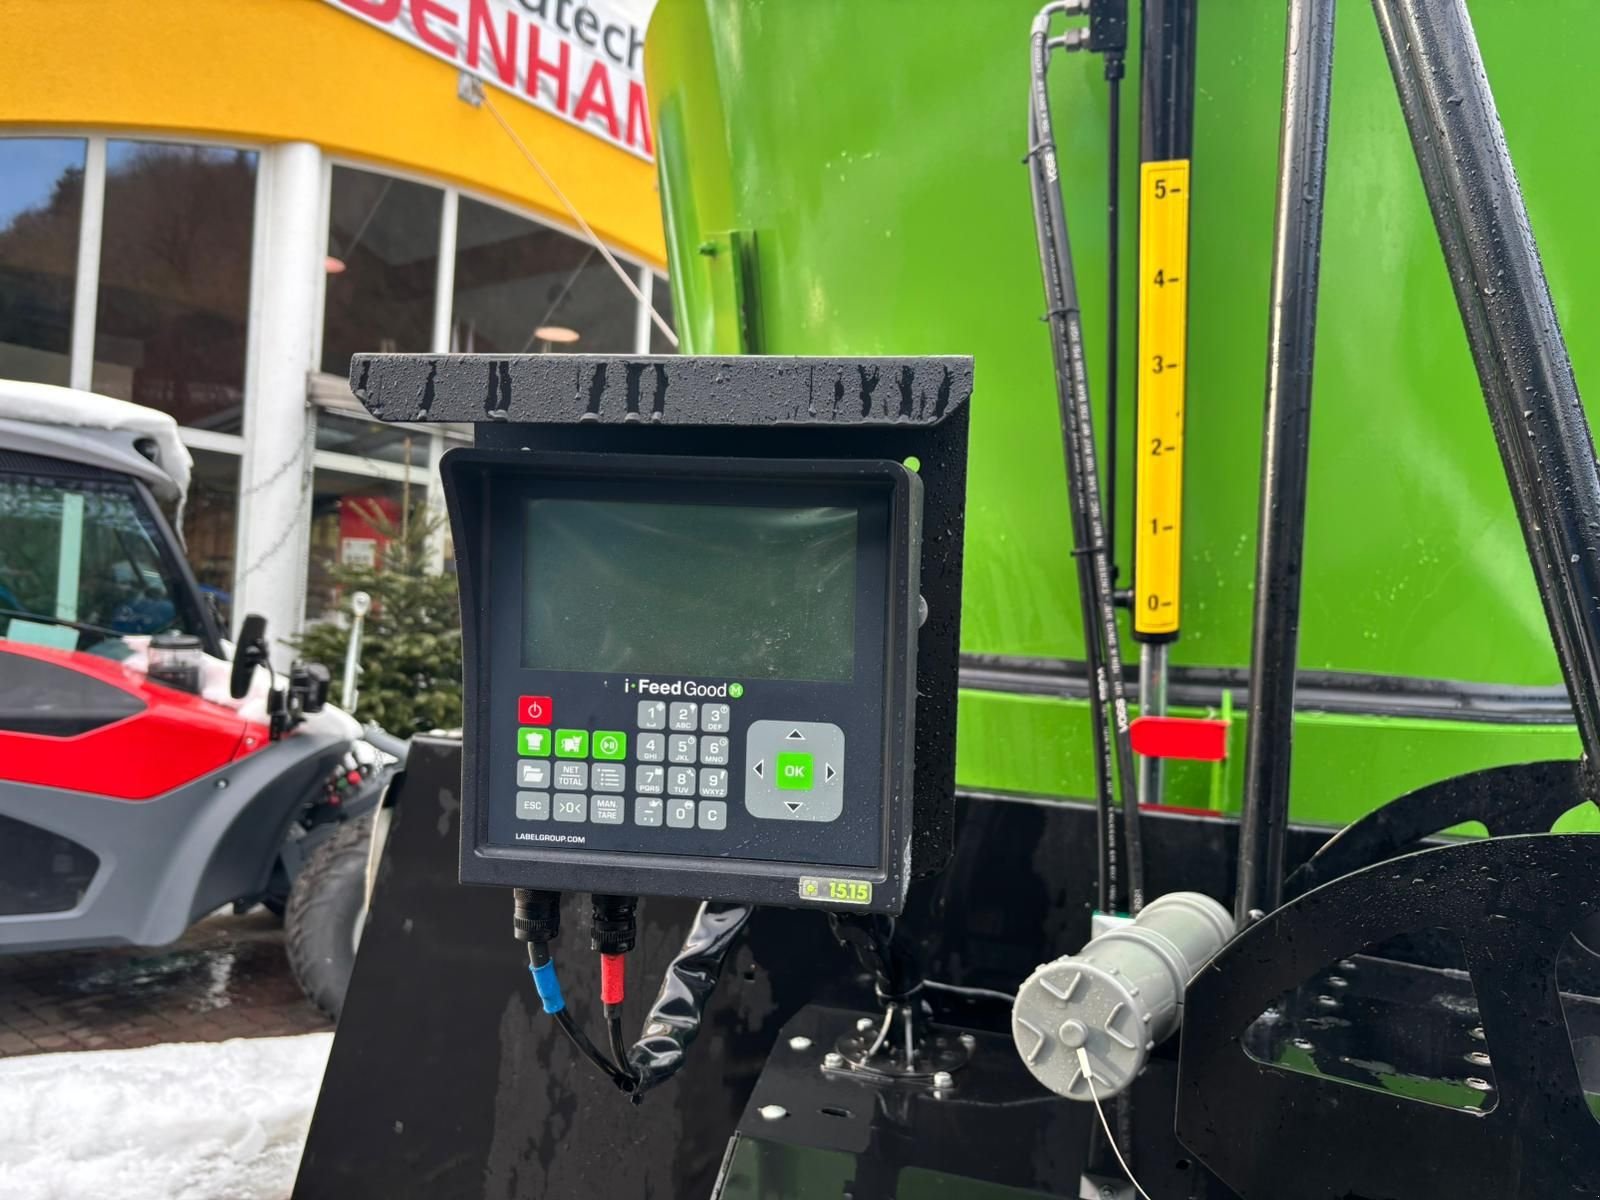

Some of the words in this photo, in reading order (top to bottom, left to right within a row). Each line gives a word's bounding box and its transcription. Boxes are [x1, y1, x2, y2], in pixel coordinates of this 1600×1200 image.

[1154, 179, 1166, 199] 5
[1153, 268, 1165, 288] 4
[1151, 355, 1164, 374] 3
[1150, 438, 1162, 456] 2
[1150, 518, 1158, 535] 1
[1147, 594, 1159, 611] 0
[647, 707, 655, 719] 1
[679, 709, 688, 720] 2
[711, 711, 720, 721] 3
[646, 740, 656, 751] 4
[678, 741, 687, 752] 5
[710, 743, 719, 754] 6
[563, 766, 579, 774] NET
[784, 765, 805, 777] OK
[559, 777, 583, 786] TOTAL
[645, 772, 654, 783] 7
[677, 774, 686, 785] 8
[709, 775, 718, 786] 9
[524, 800, 541, 810] ESC
[597, 811, 617, 820] TARE
[707, 810, 717, 821] C
[515, 833, 586, 843] LABELGROUP.COM
